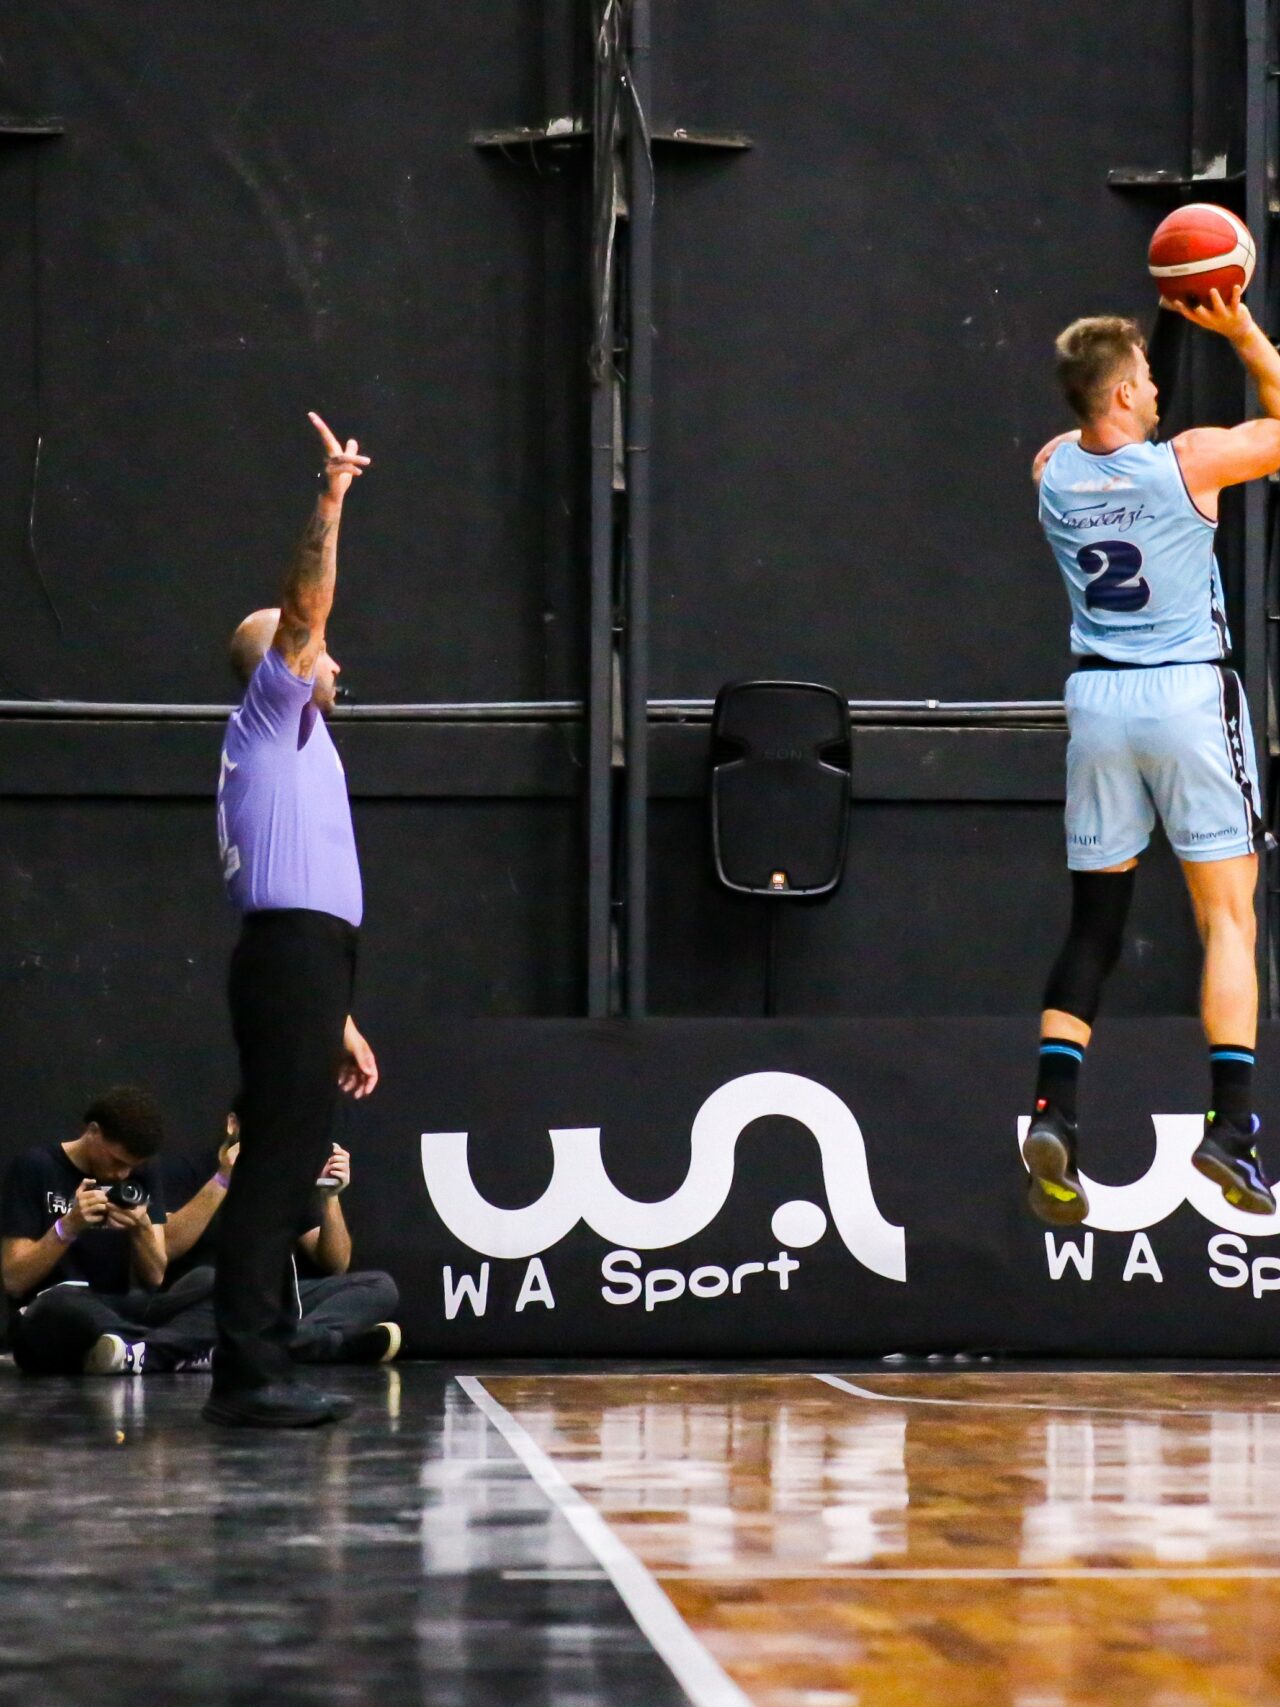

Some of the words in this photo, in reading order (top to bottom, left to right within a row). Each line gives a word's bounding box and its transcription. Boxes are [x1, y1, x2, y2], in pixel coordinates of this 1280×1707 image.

[1076, 540, 1151, 612] 2
[1191, 826, 1238, 841] Heavenly
[443, 1262, 490, 1320] W
[515, 1258, 555, 1312] A
[601, 1249, 800, 1311] Sport
[1045, 1232, 1094, 1281] W
[1123, 1232, 1163, 1283] A
